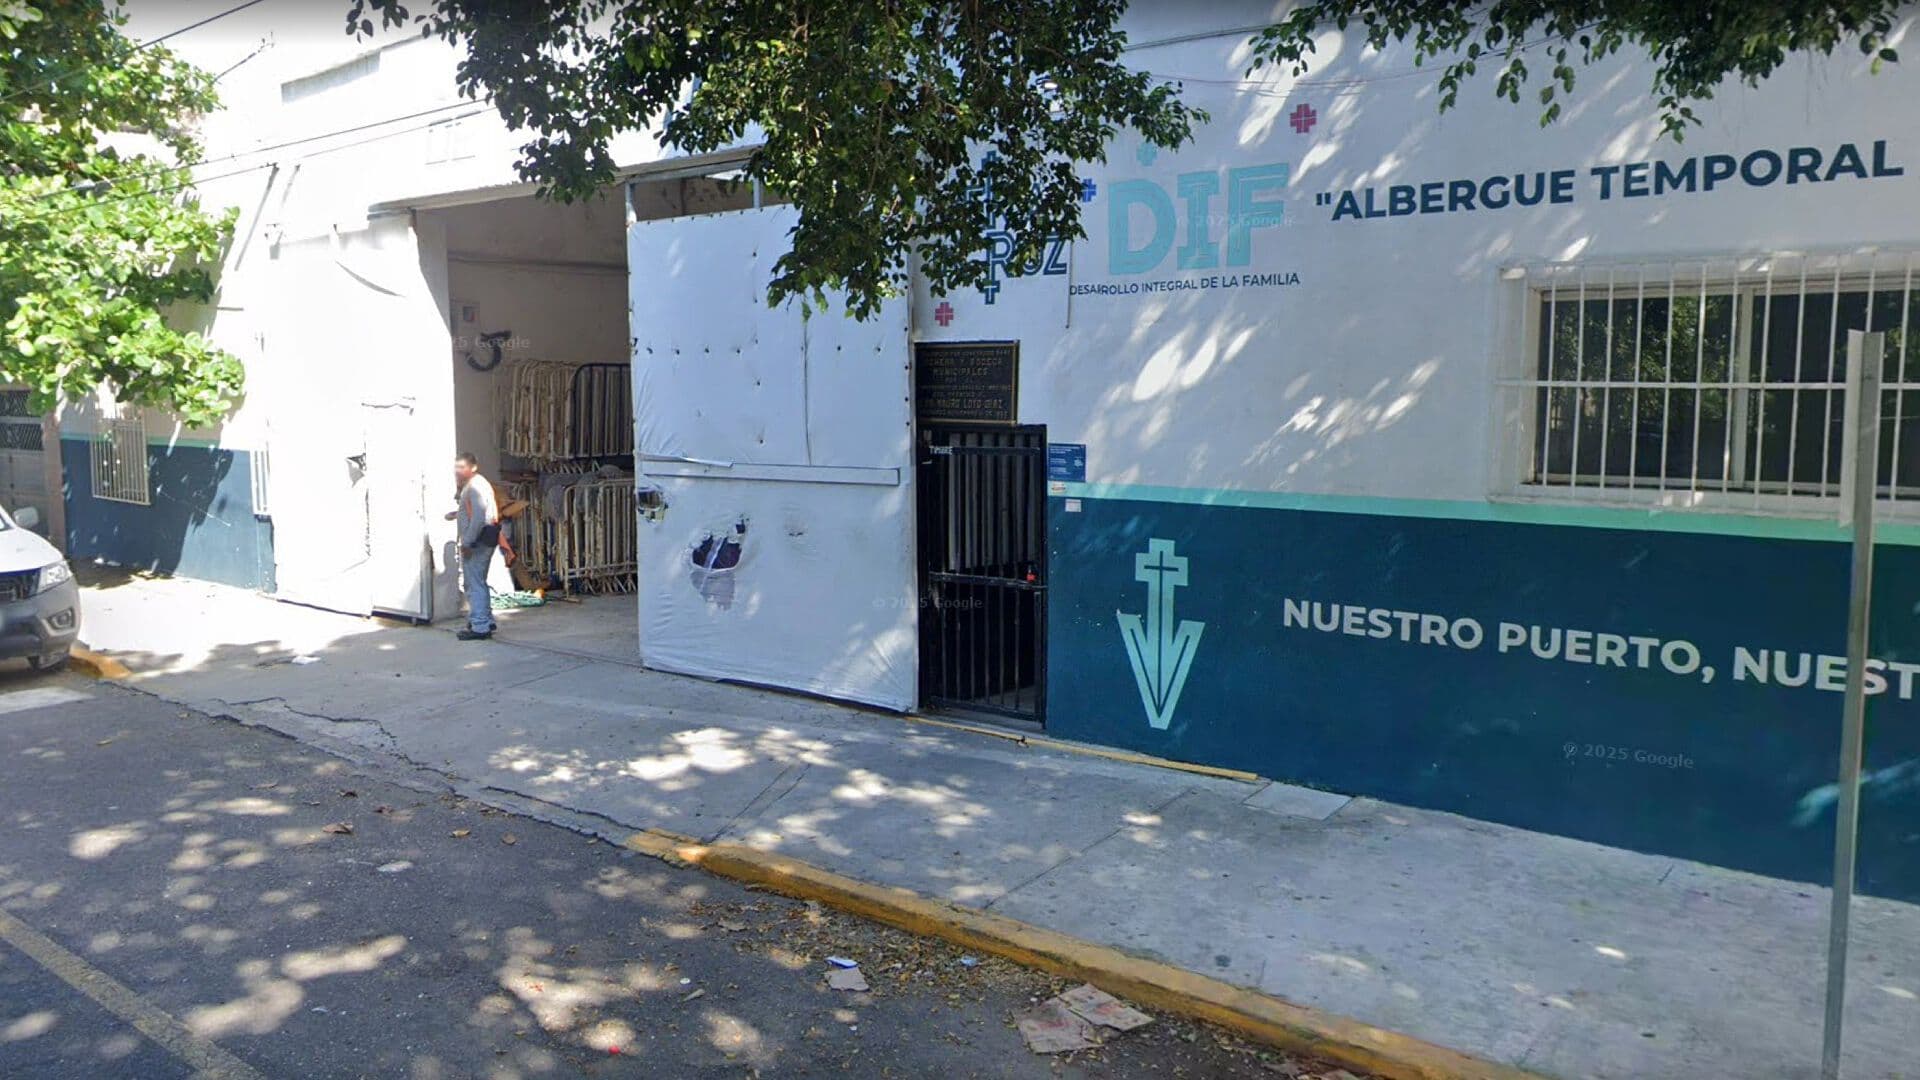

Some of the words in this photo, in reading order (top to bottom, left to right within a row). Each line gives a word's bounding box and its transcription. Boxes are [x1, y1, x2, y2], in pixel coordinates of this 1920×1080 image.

[1108, 163, 1290, 275] DIF
[1315, 169, 1575, 221] "ALBERGUE
[1590, 140, 1904, 200] TEMPORAL
[984, 230, 1068, 279] RUZ
[1142, 280, 1197, 292] INTEGRAL
[1201, 277, 1218, 289] DE
[1222, 276, 1238, 287] LA
[1242, 272, 1301, 287] FAMILIA
[1283, 597, 1484, 650] NUESTRO
[1497, 621, 1716, 684] PUERTO,
